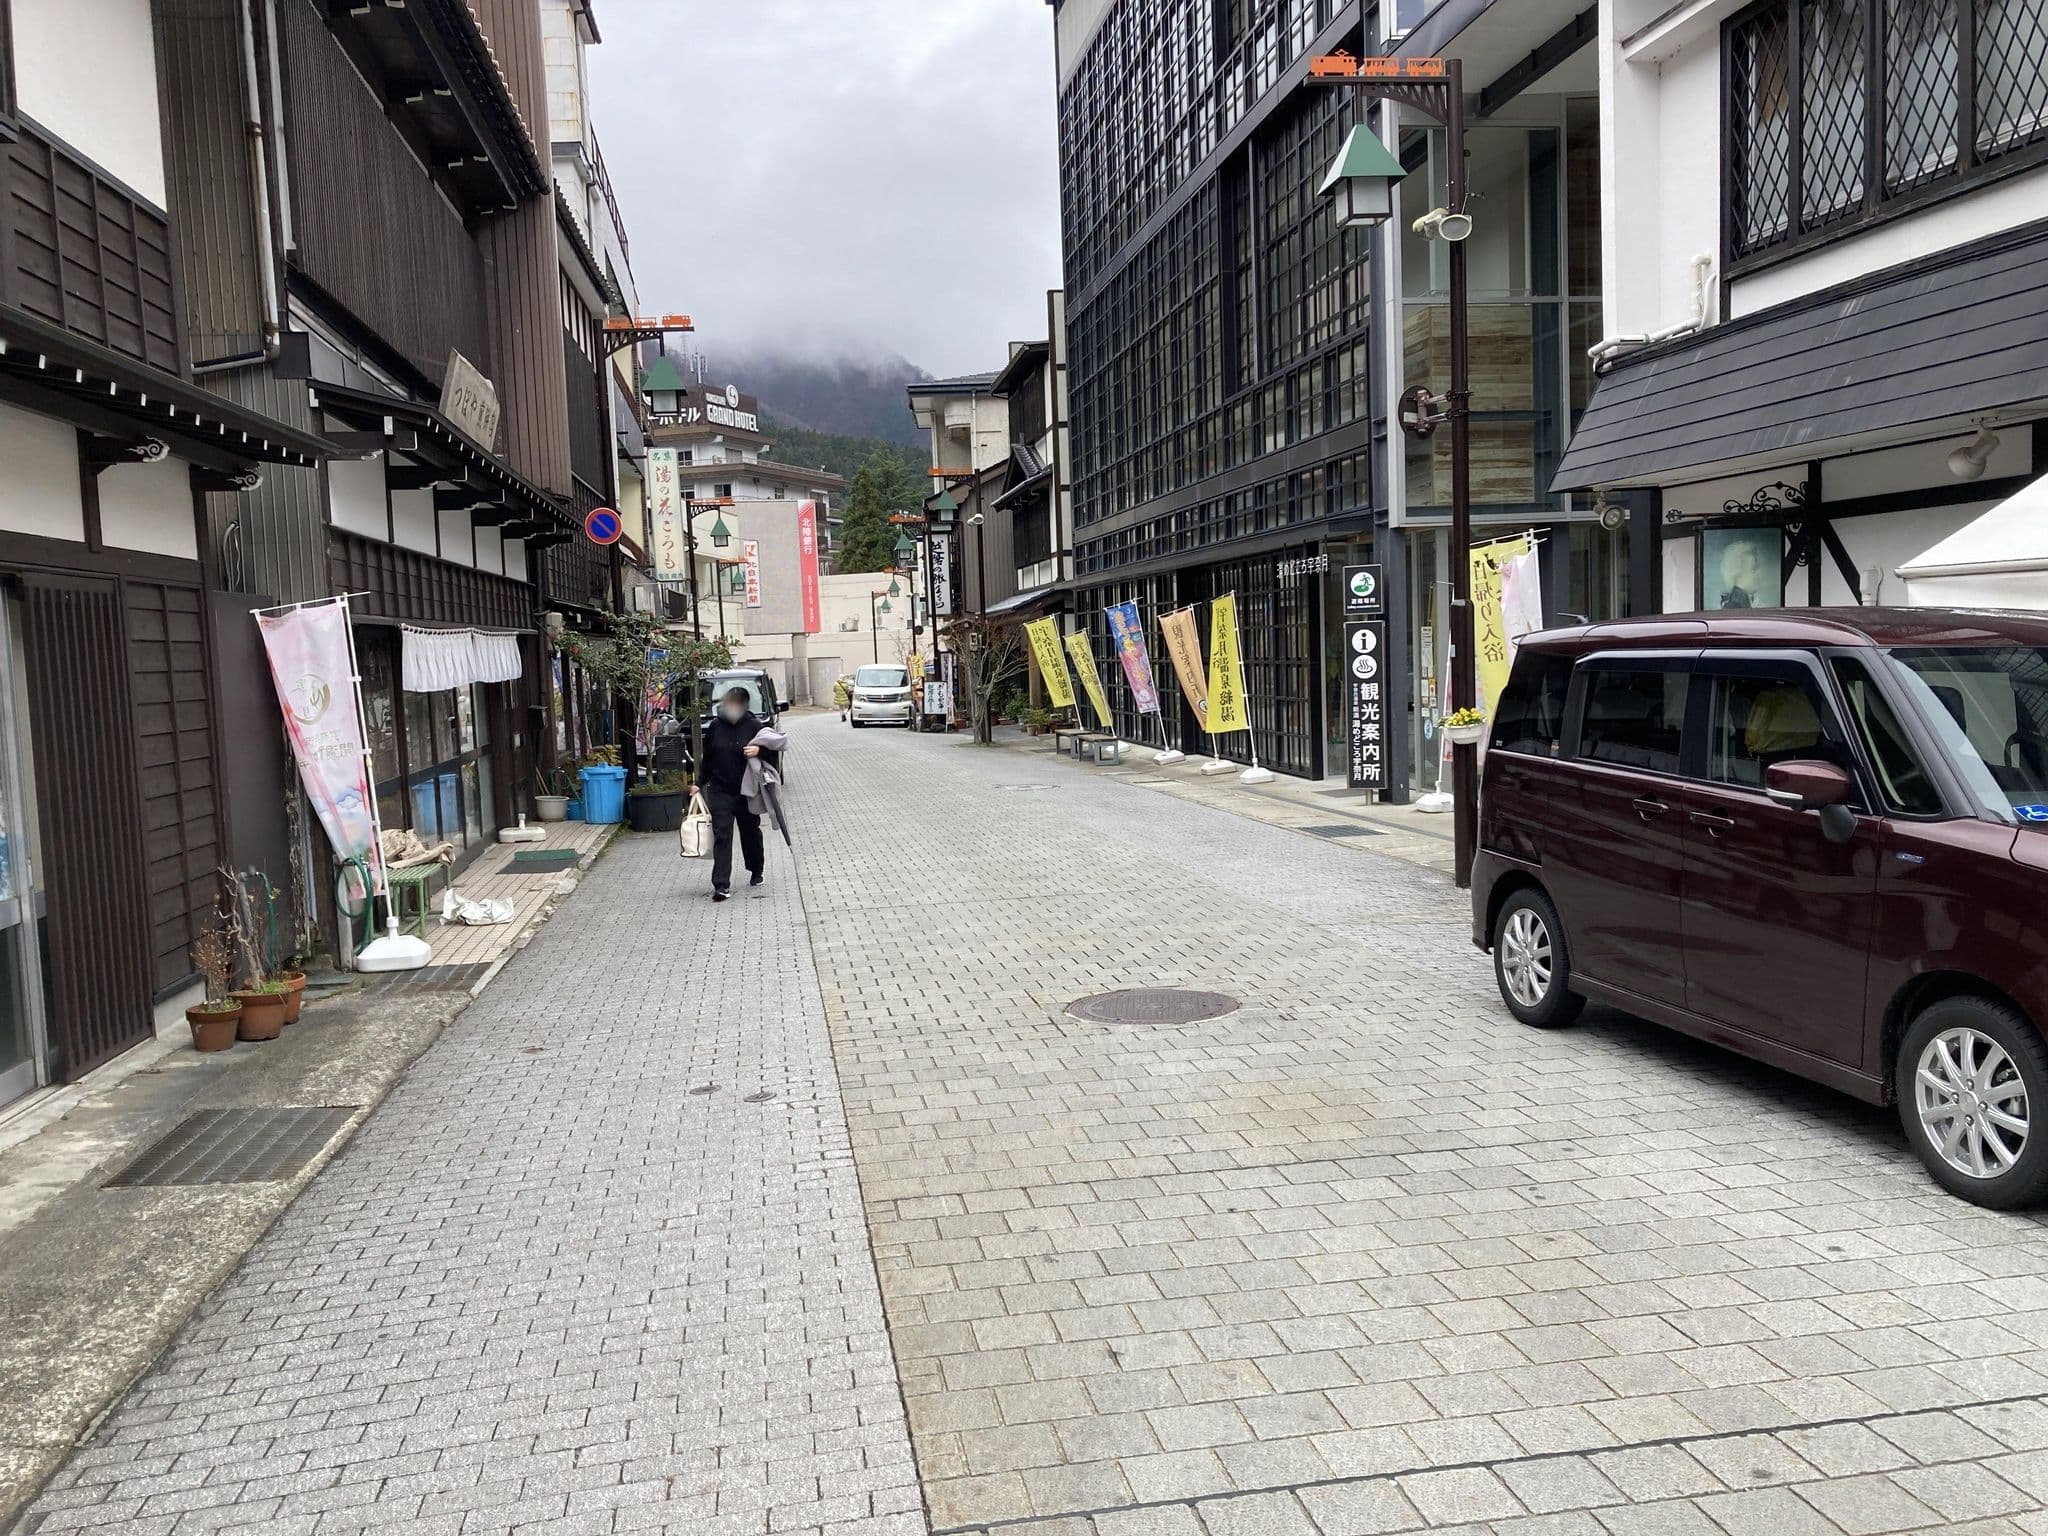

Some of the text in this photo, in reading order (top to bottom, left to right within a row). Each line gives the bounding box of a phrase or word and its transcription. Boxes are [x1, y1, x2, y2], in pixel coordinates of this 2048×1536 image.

[706, 403, 759, 433] GRAND HOTEL
[655, 464, 676, 570] 湯の花ころも
[802, 517, 813, 555] 北陸銀行
[747, 561, 759, 605] 北日本新聞
[1352, 719, 1362, 781] 湯めどころ宇奈月
[1361, 683, 1381, 781] 観光案内所
